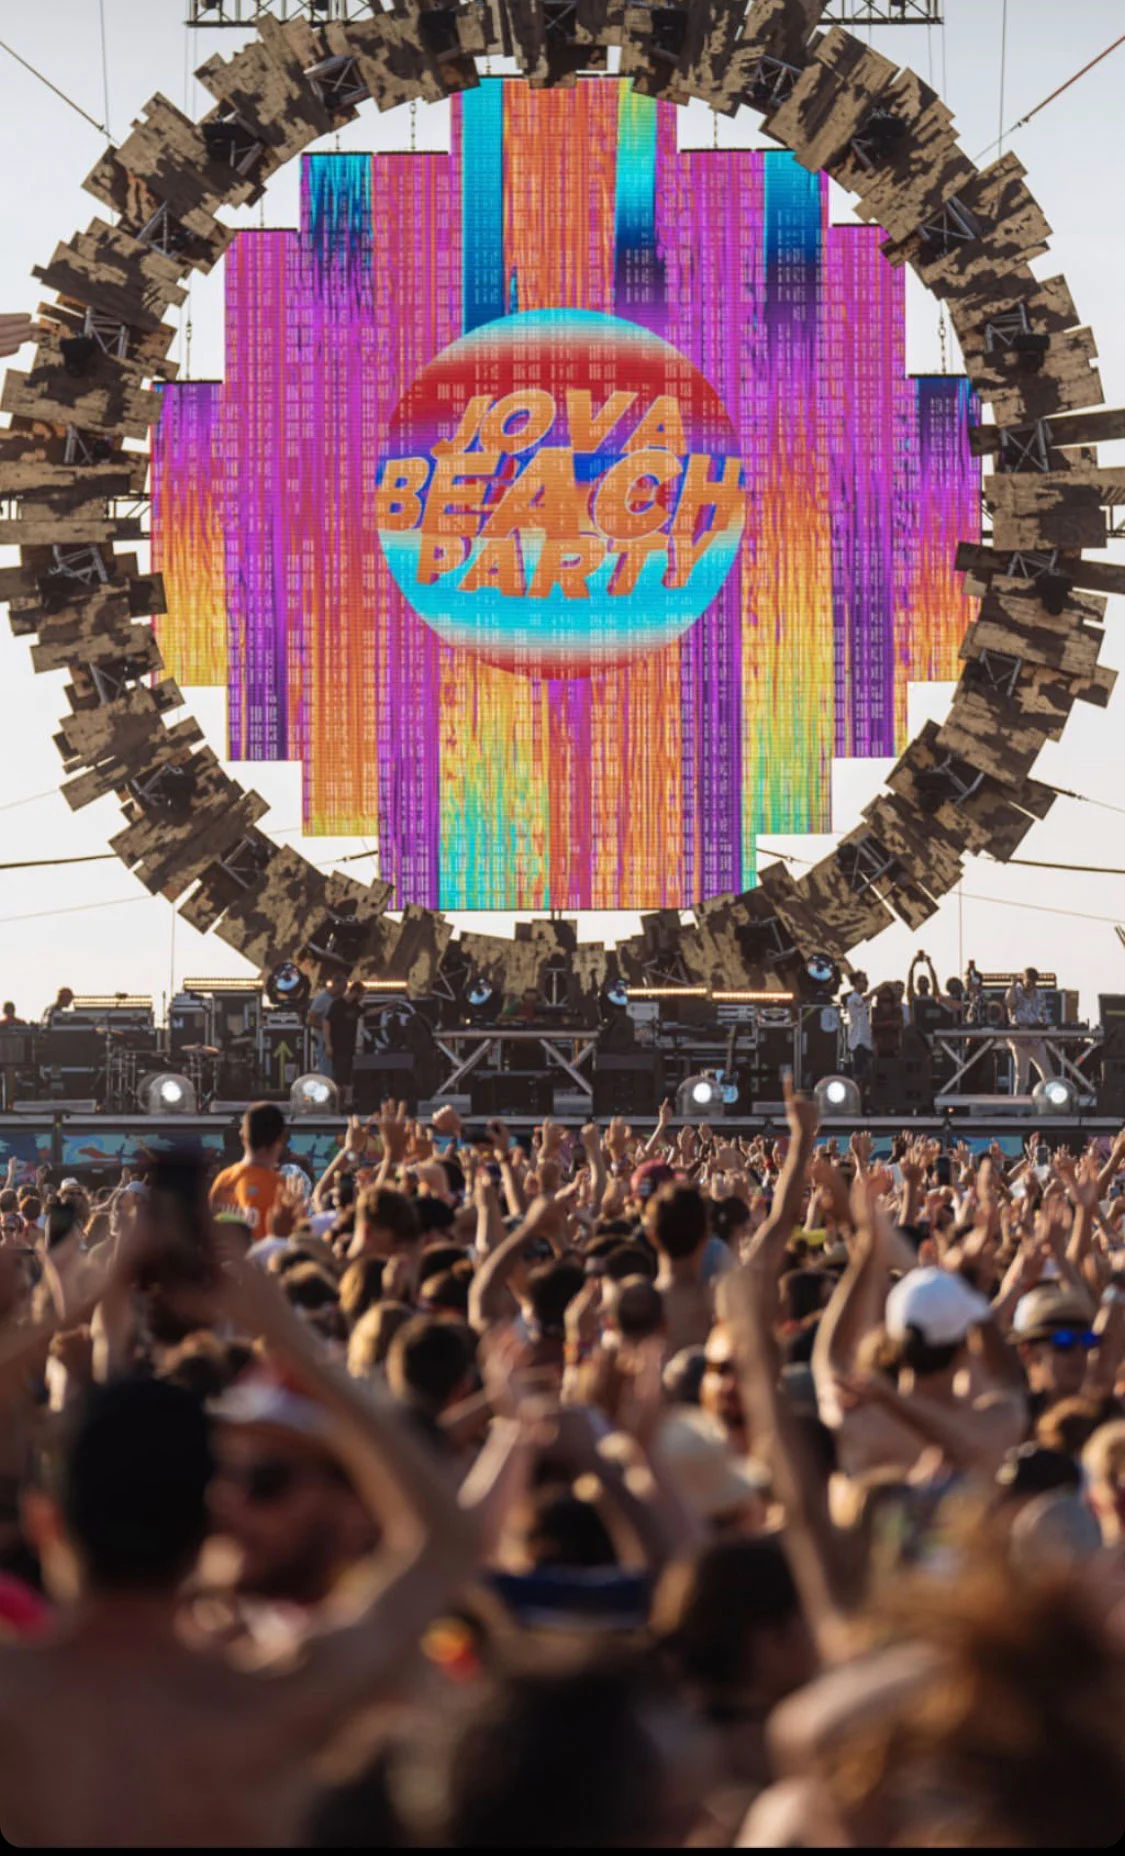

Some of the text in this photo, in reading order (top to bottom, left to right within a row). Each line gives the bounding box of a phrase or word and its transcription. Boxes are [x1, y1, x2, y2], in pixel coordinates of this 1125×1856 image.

[431, 388, 688, 458] JOVA
[378, 447, 746, 540] BEACH
[416, 530, 719, 599] PARTY
